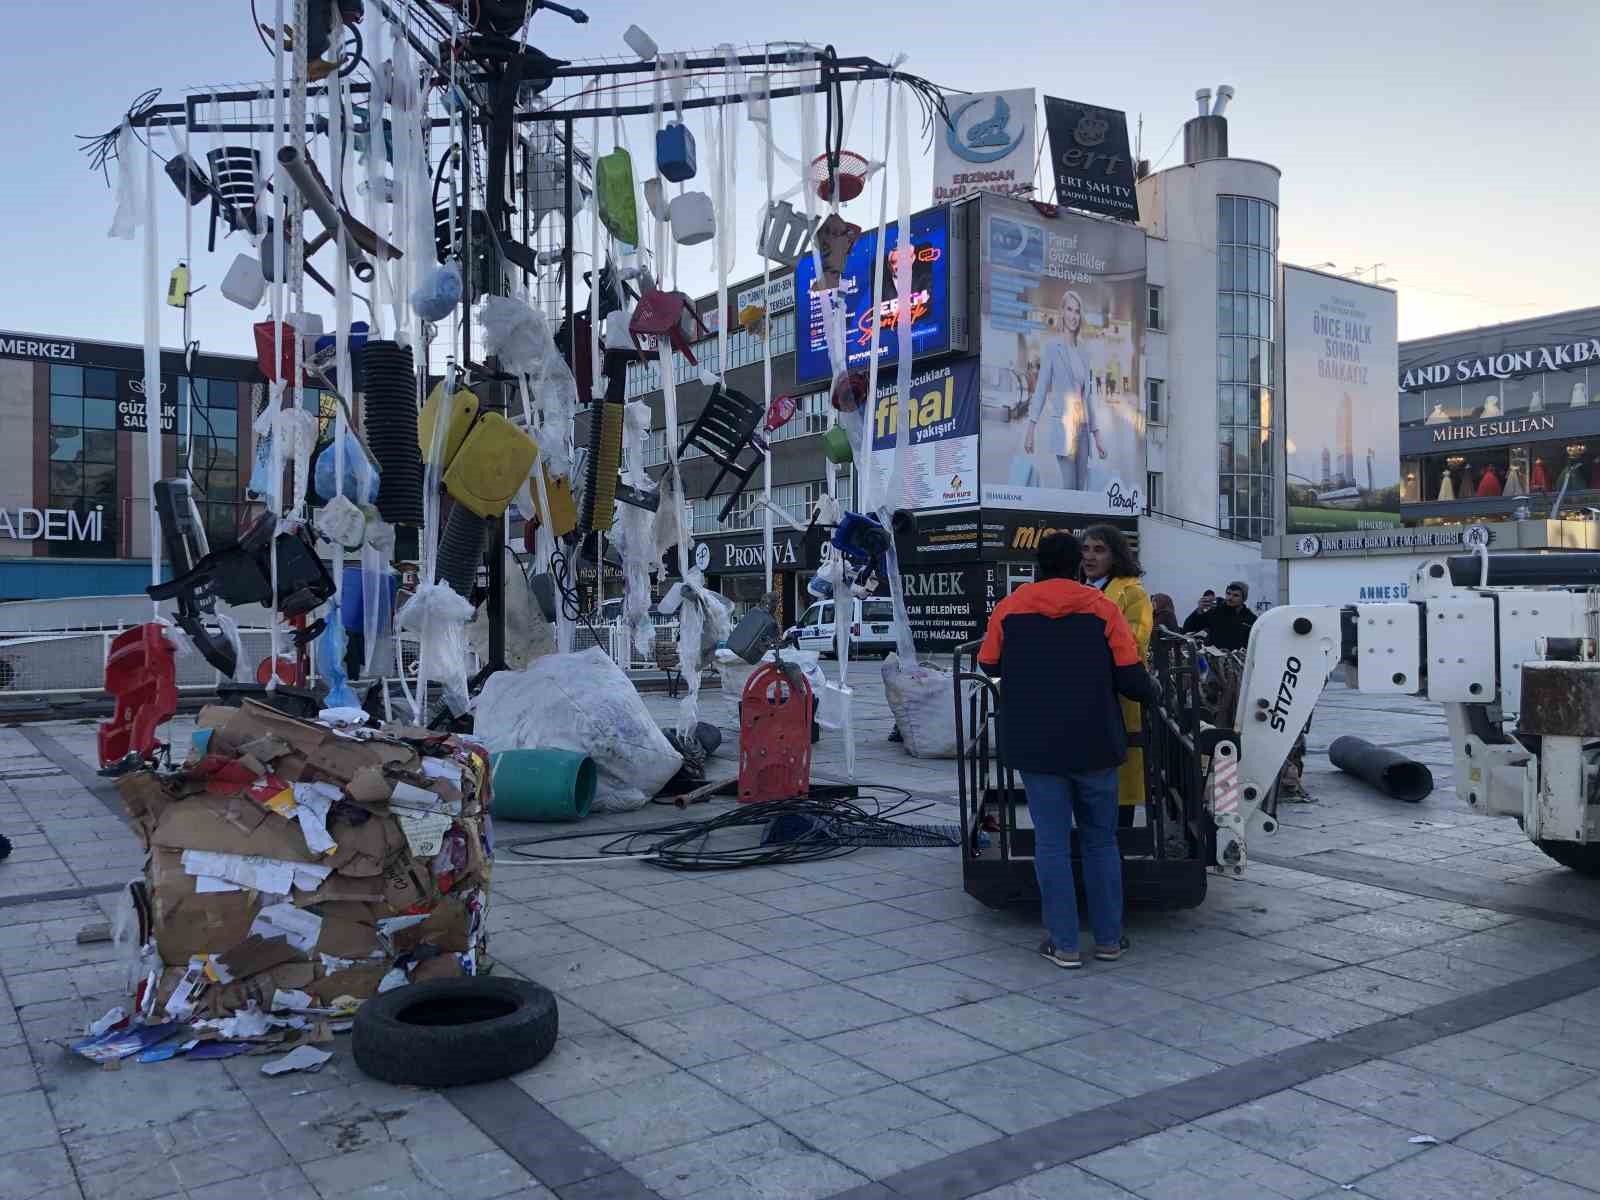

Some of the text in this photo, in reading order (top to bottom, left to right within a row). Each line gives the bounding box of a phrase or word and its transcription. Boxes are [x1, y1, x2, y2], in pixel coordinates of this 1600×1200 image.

[1060, 175, 1081, 187] ERT
[1113, 185, 1130, 197] TV
[1344, 321, 1372, 344] HALK
[0, 339, 75, 359] MERKEZİ
[1456, 350, 1533, 379] SALON
[916, 418, 956, 442] yakışır!
[724, 538, 796, 567] PRONVA
[901, 572, 965, 596] RMEK
[926, 602, 970, 615] BELEDİYESİ
[912, 629, 929, 642] ATIŞ
